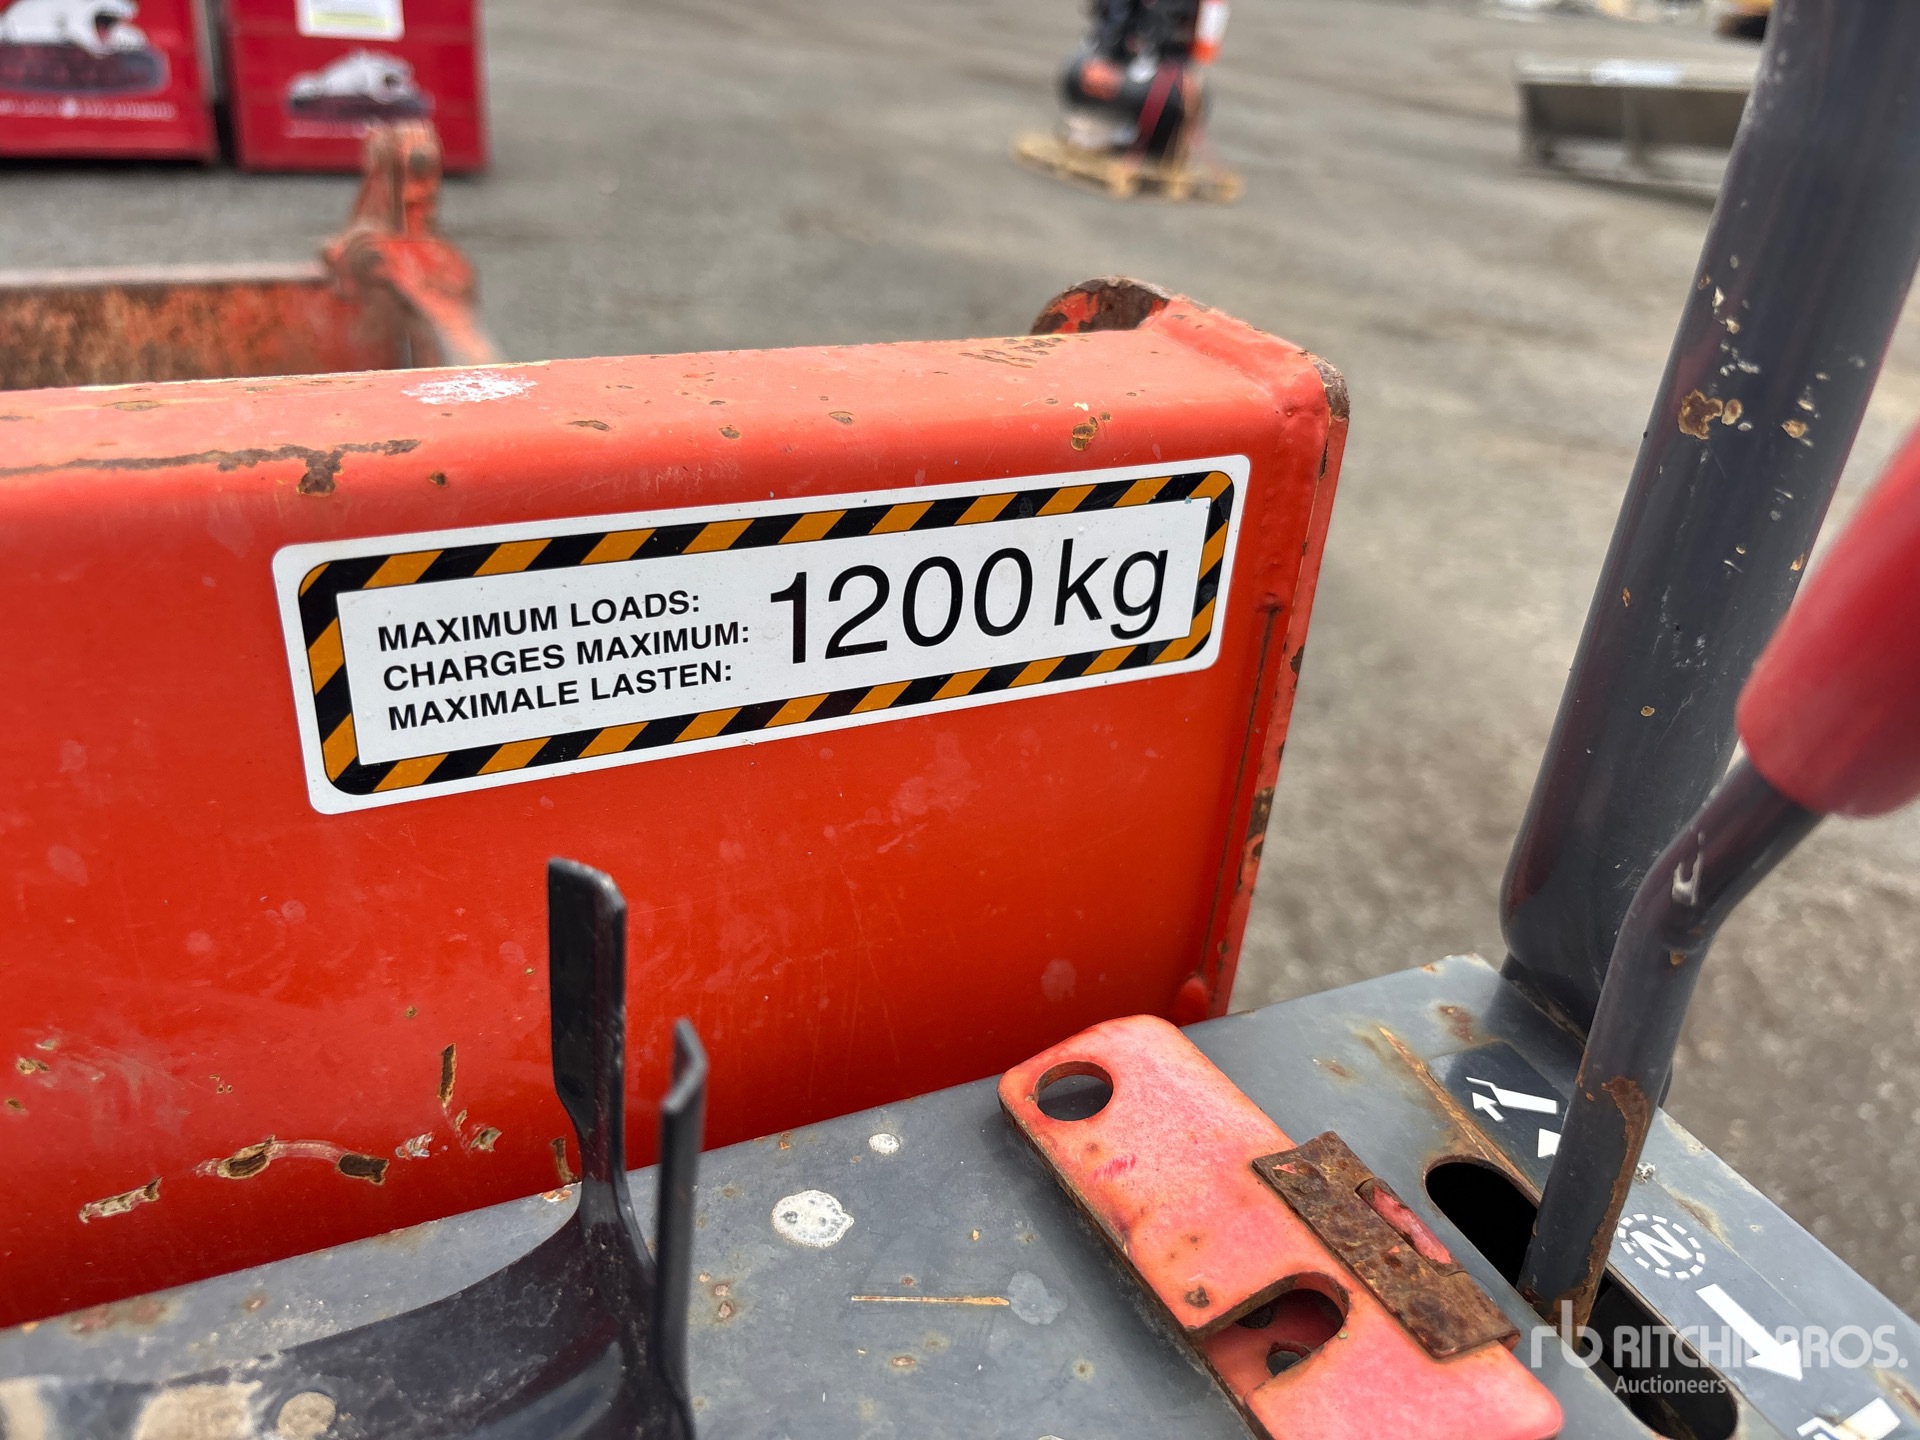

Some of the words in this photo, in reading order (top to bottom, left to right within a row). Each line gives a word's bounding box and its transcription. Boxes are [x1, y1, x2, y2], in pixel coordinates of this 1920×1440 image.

[378, 606, 558, 651] MAXIMUM
[570, 590, 700, 627] LOADS:
[770, 547, 1033, 664] 1200
[1054, 538, 1168, 640] kg
[383, 644, 565, 691] CHARGES
[576, 621, 750, 665] MAXIMUM:
[388, 680, 579, 730] MAXIMALE
[591, 660, 732, 700] LASTEN:
[1630, 1223, 1692, 1268] N
